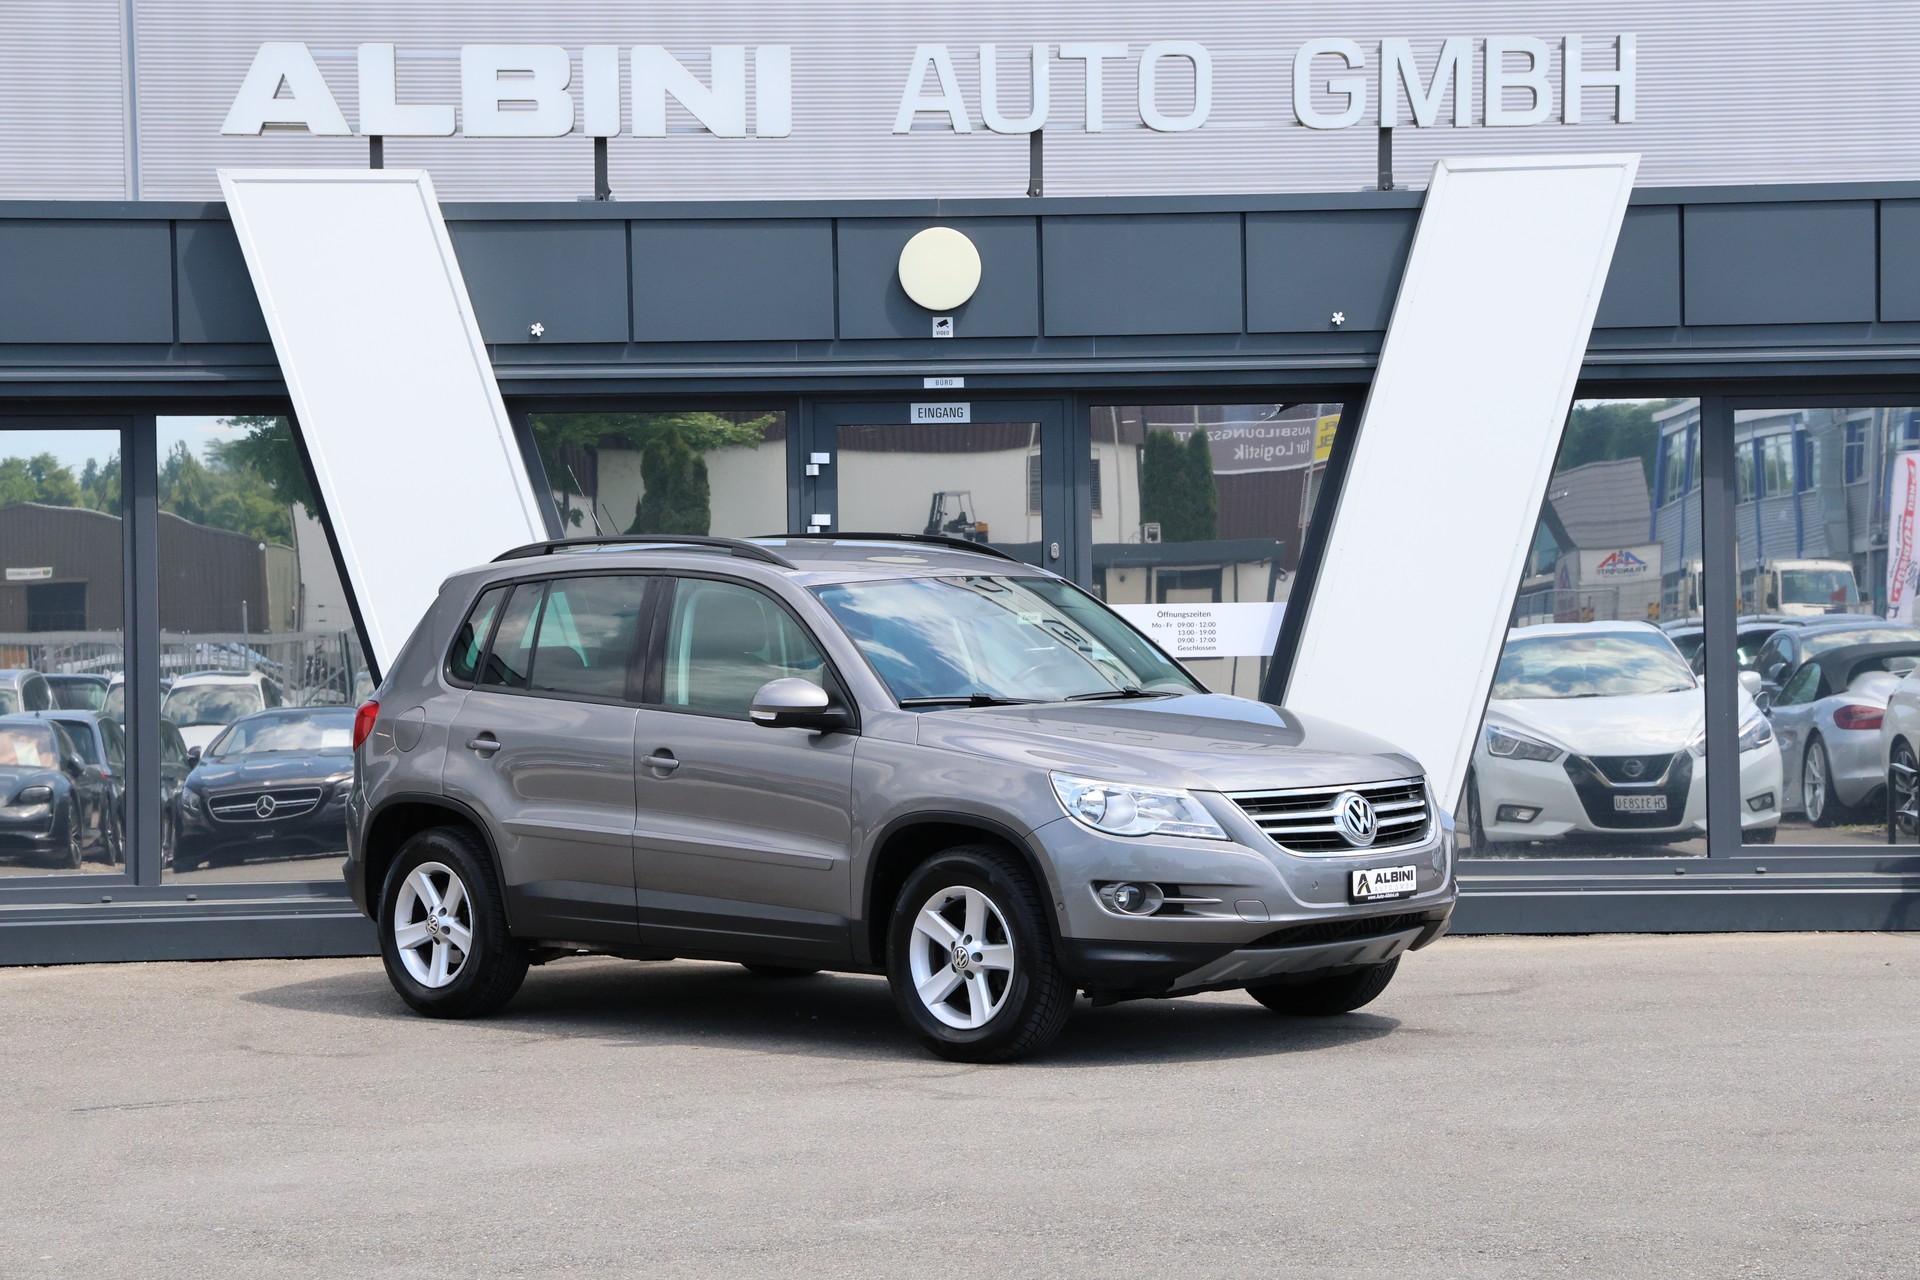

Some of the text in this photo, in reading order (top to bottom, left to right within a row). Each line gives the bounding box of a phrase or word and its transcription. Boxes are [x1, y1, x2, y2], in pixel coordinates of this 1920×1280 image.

[220, 33, 1637, 139] ALBINI AUTO GMBH
[935, 378, 953, 386] BÜRO
[918, 407, 964, 418] EINGANG
[1156, 610, 1212, 618] Öffnungszeiten
[1375, 869, 1414, 884] ALBINI
